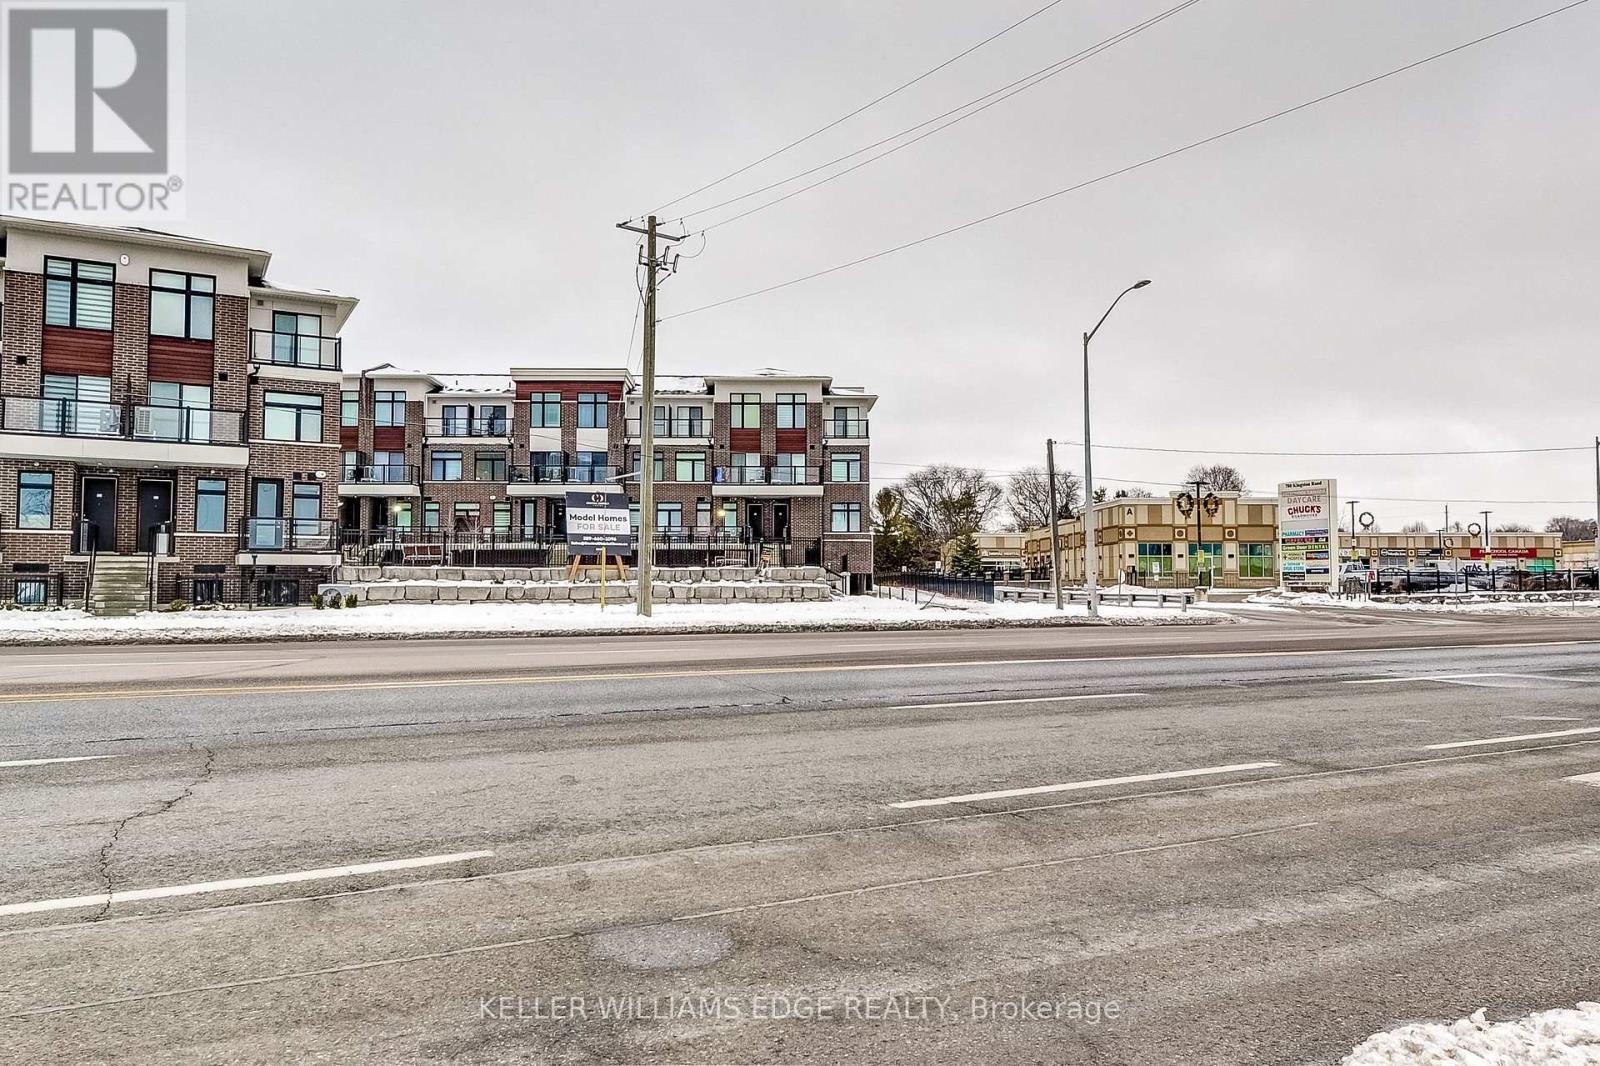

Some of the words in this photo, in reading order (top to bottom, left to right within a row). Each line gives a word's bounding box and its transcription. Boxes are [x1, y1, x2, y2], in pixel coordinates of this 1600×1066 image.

[1287, 495, 1321, 504] DAYCARE
[1126, 507, 1133, 516] A
[1287, 505, 1321, 515] CHUCK'S
[569, 513, 596, 521] Model
[598, 514, 628, 522] Homes
[577, 523, 596, 531] FOR
[598, 523, 621, 531] SALE
